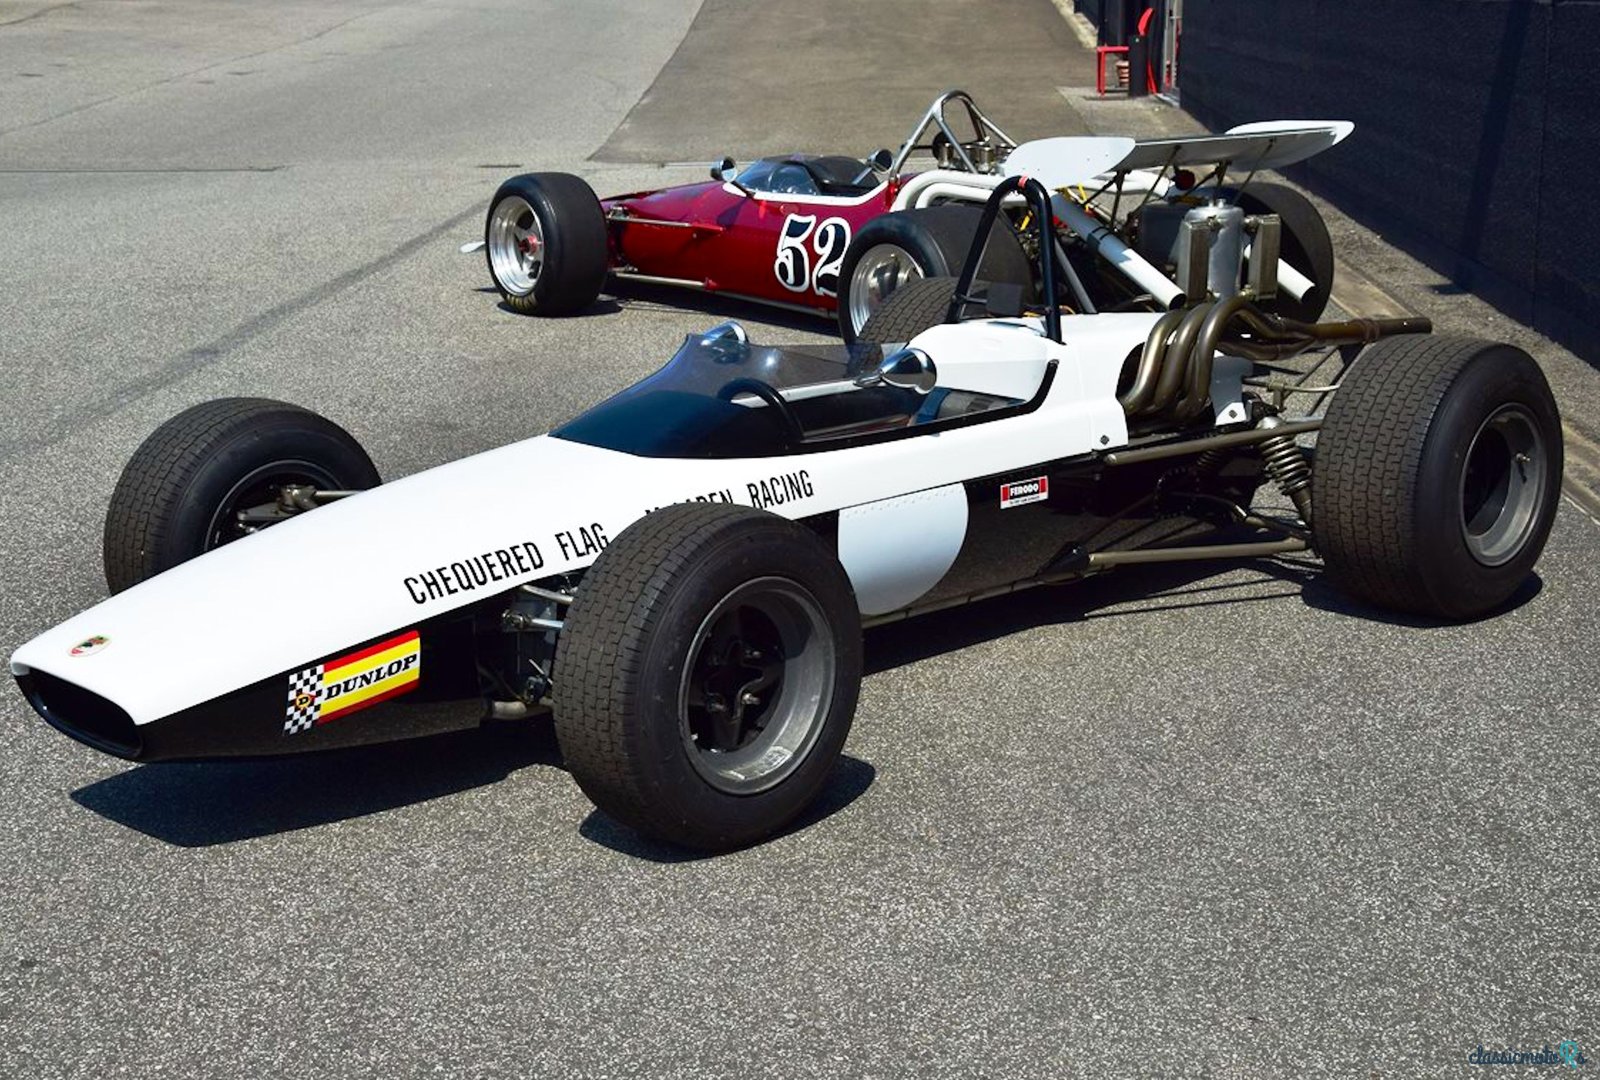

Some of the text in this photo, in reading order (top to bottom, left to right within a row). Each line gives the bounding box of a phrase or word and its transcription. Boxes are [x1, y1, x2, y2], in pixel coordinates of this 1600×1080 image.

[774, 213, 851, 298] 52
[1010, 483, 1039, 496] FERODO
[403, 541, 545, 605] CHEQUERED
[554, 522, 610, 562] FLAG
[746, 469, 814, 510] RACING
[324, 653, 418, 701] DUNLOP
